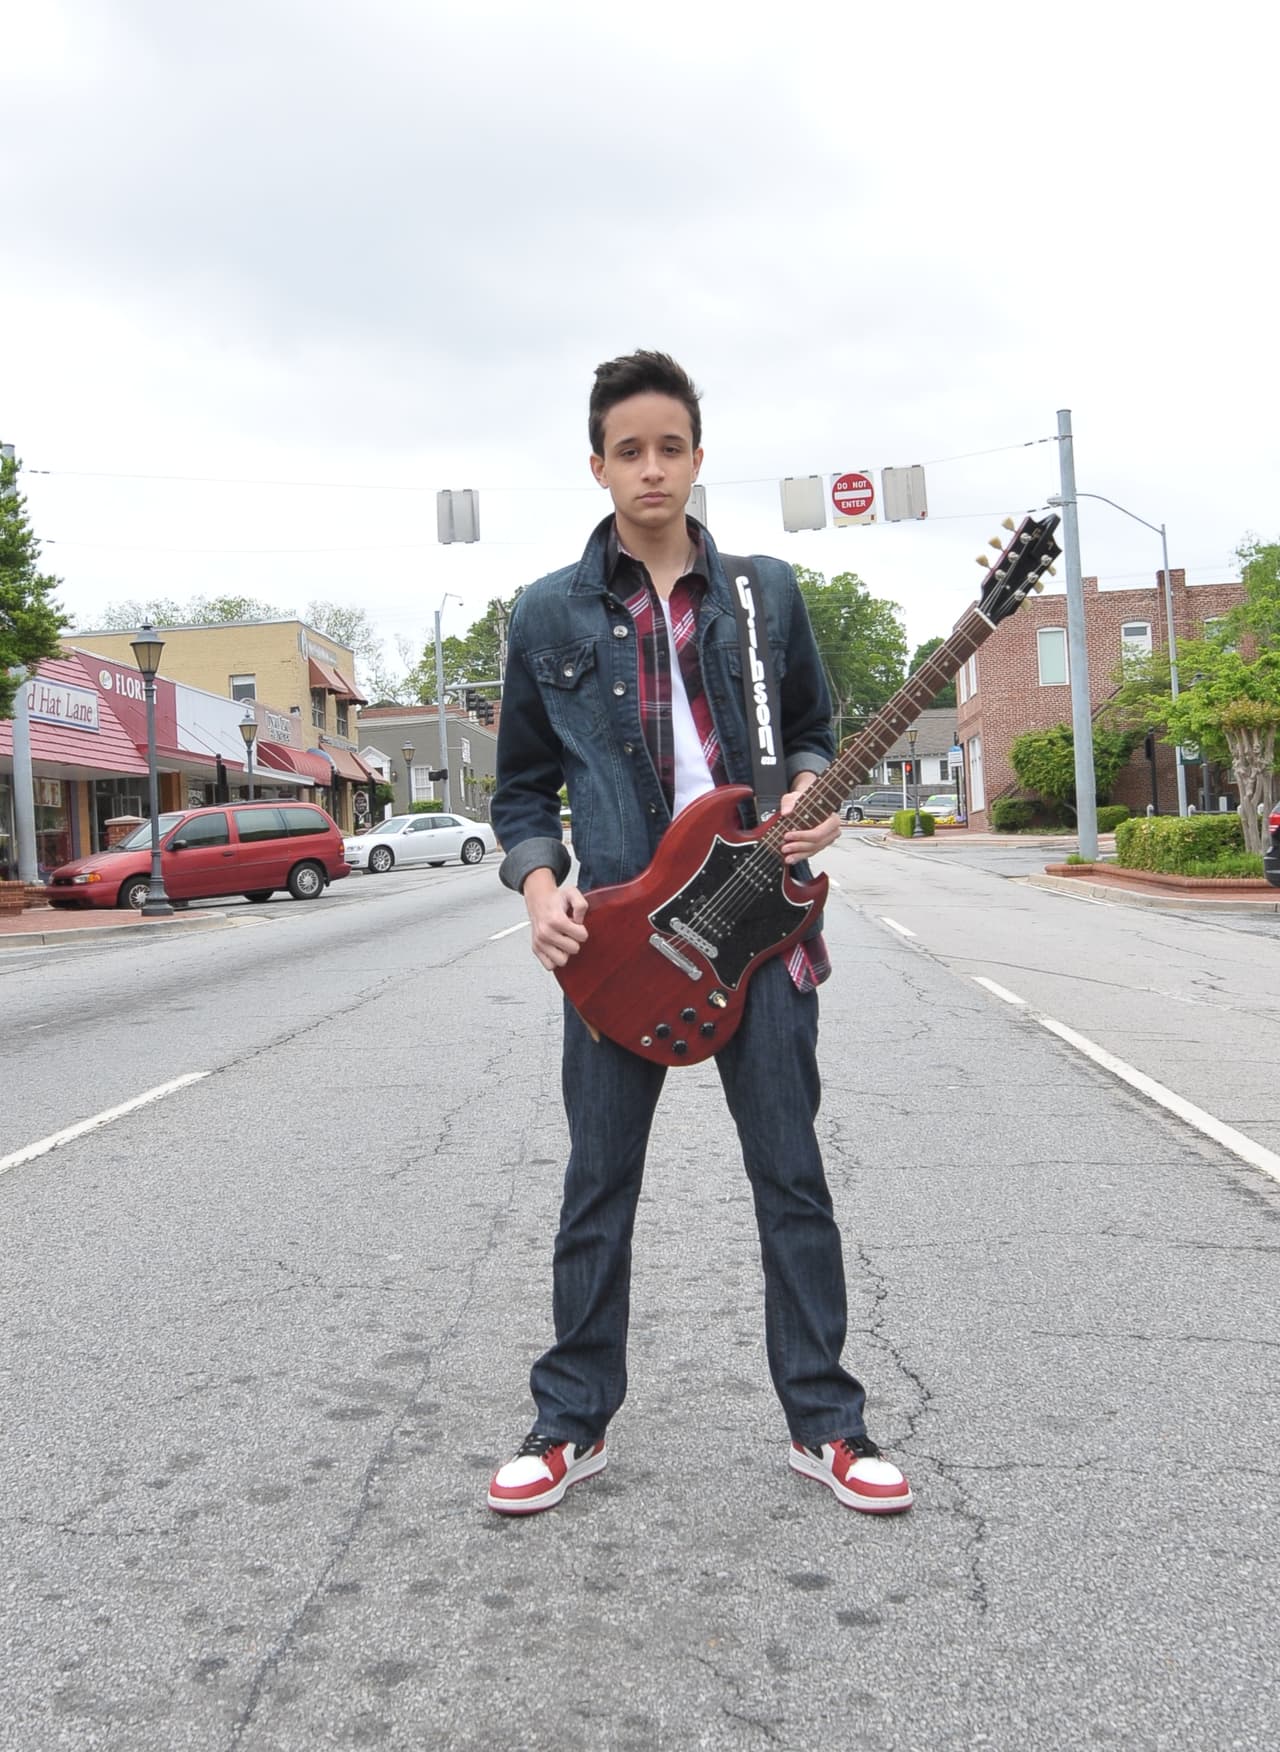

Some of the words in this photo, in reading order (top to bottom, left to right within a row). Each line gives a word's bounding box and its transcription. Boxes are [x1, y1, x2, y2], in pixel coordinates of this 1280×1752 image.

[837, 482, 848, 490] DO
[852, 480, 867, 488] NOT
[841, 500, 866, 509] ENTER
[735, 576, 775, 756] Gibson
[39, 686, 62, 716] Hat
[65, 693, 93, 722] Lane
[116, 673, 158, 704] FLORIT
